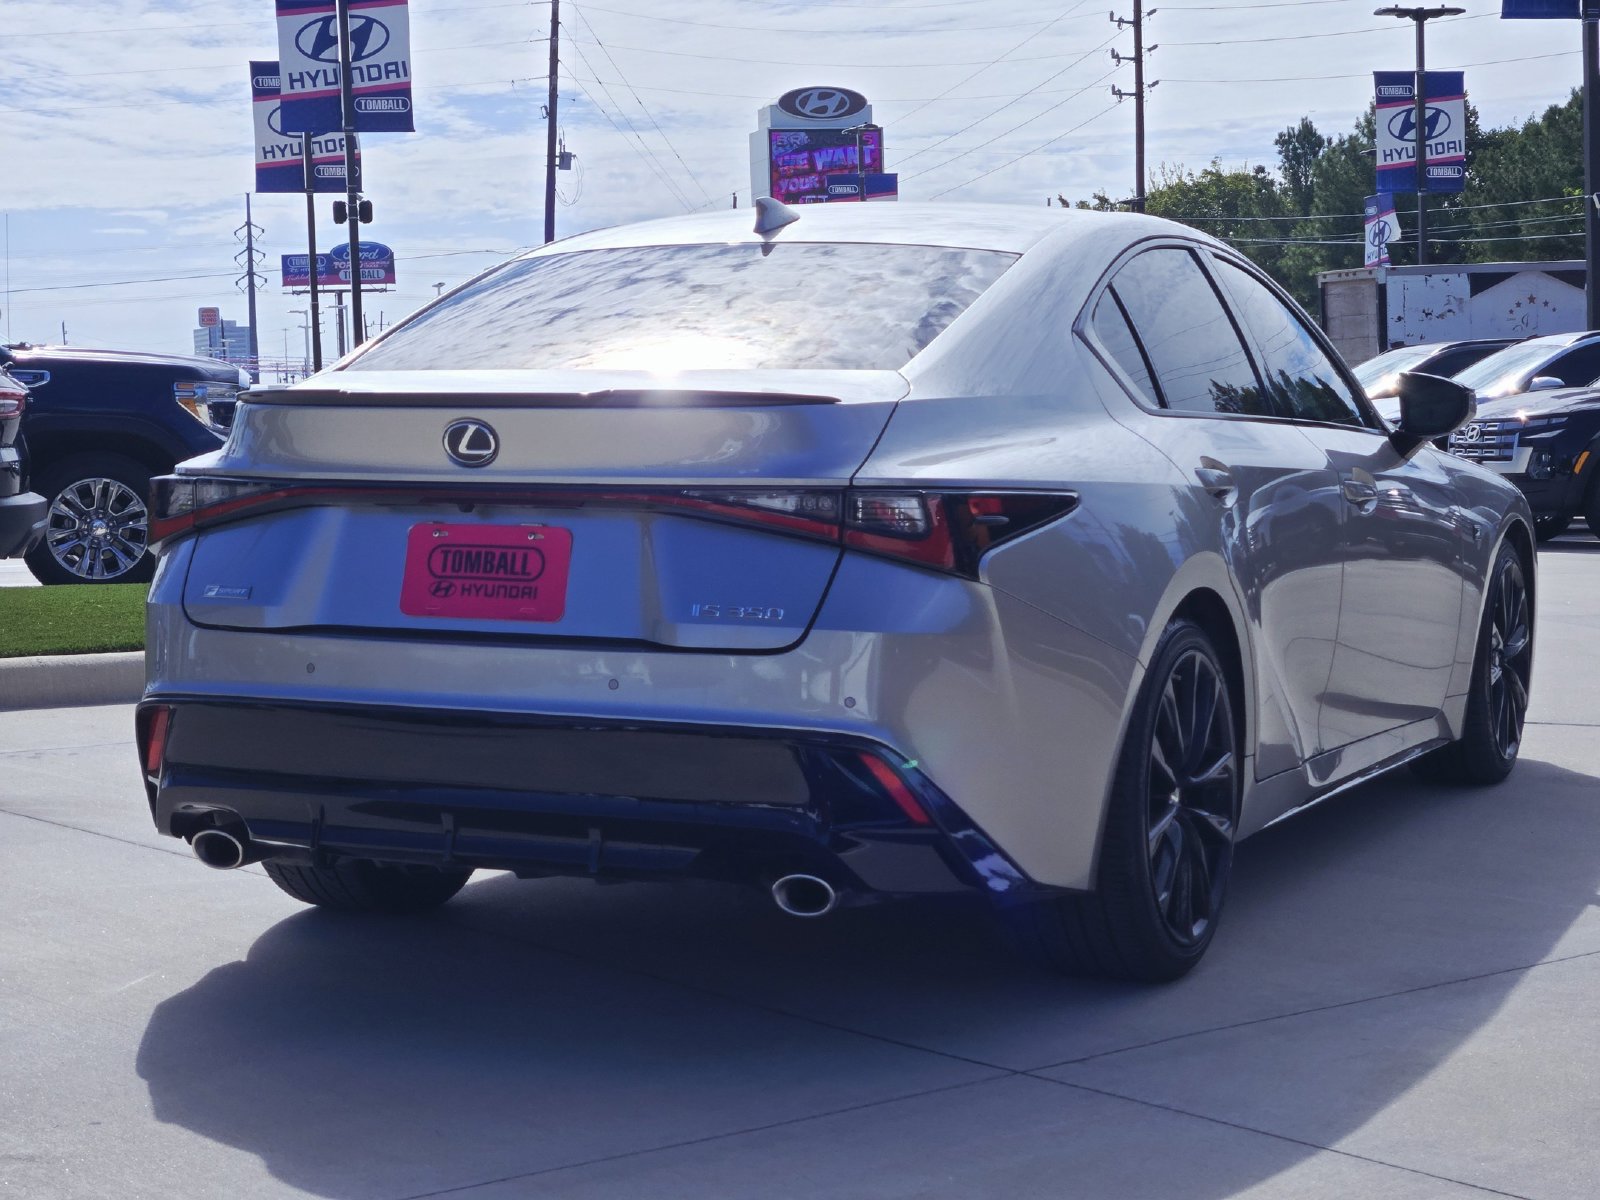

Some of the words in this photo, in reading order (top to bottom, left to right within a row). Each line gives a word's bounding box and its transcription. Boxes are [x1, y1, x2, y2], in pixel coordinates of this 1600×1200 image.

[258, 78, 281, 87] TOMB
[288, 61, 408, 90] HYUNDAI
[1381, 87, 1411, 95] TOMBALL
[360, 99, 405, 110] TOMBALL
[813, 145, 875, 171] WANT
[319, 167, 346, 176] TOMBA
[1429, 168, 1459, 176] TOMBALL
[440, 549, 532, 577] TOMBALL
[460, 583, 538, 600] HYUNDAI
[691, 603, 720, 617] IS
[727, 606, 784, 620] 350
